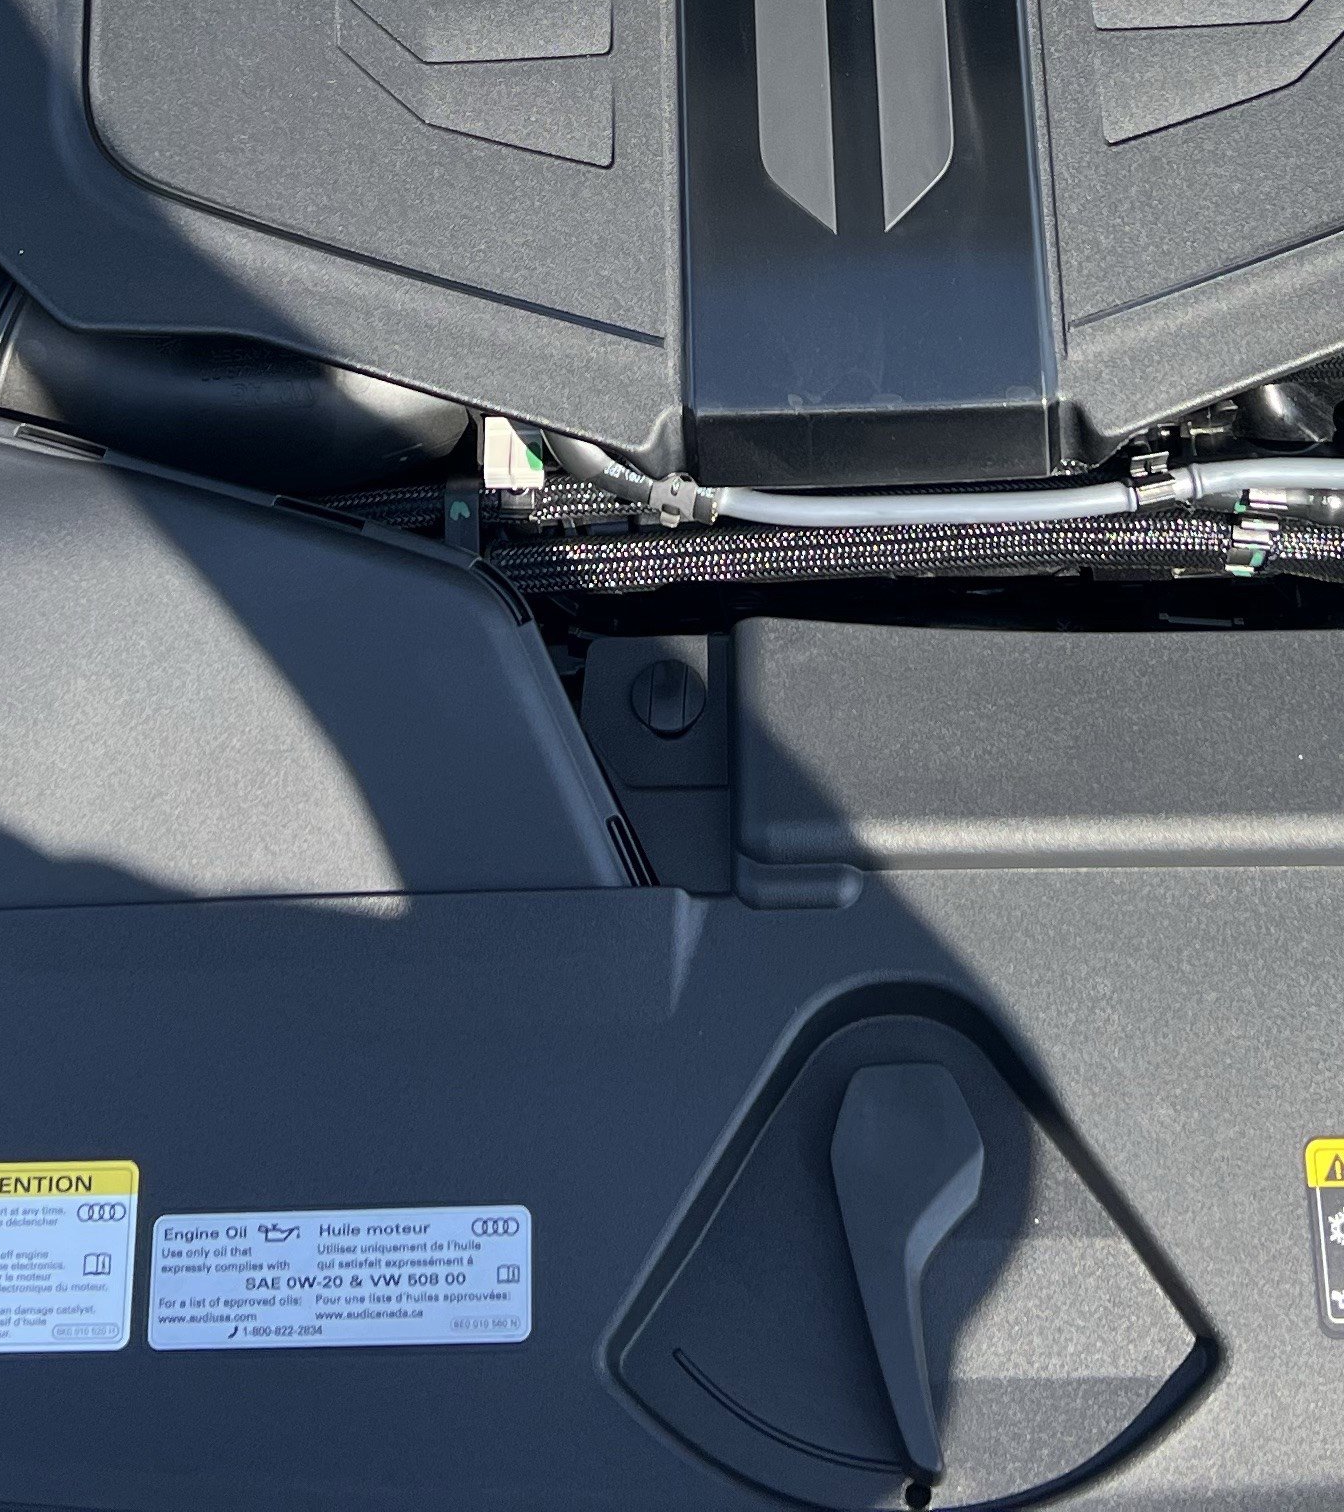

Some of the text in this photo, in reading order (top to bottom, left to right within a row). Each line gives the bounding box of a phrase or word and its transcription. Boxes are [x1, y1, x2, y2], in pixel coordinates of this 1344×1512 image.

[164, 1225, 248, 1244] Engine Oil
[319, 1222, 431, 1238] Huile moteur
[161, 1246, 252, 1259] Use only oil that
[360, 1242, 428, 1256] uniquement
[430, 1240, 444, 1252] de
[161, 1260, 290, 1275] expressly complies with
[316, 1258, 336, 1271] qui
[245, 1272, 466, 1290] SAE 0W-20 & VW 508 00
[158, 1297, 178, 1309] For
[190, 1296, 206, 1308] list
[208, 1296, 220, 1308] of
[223, 1295, 276, 1310] approved
[315, 1293, 342, 1305] Pour
[344, 1295, 366, 1304] une
[158, 1312, 258, 1324] www.audiusa.com
[314, 1308, 424, 1321] www.audicanada.ca
